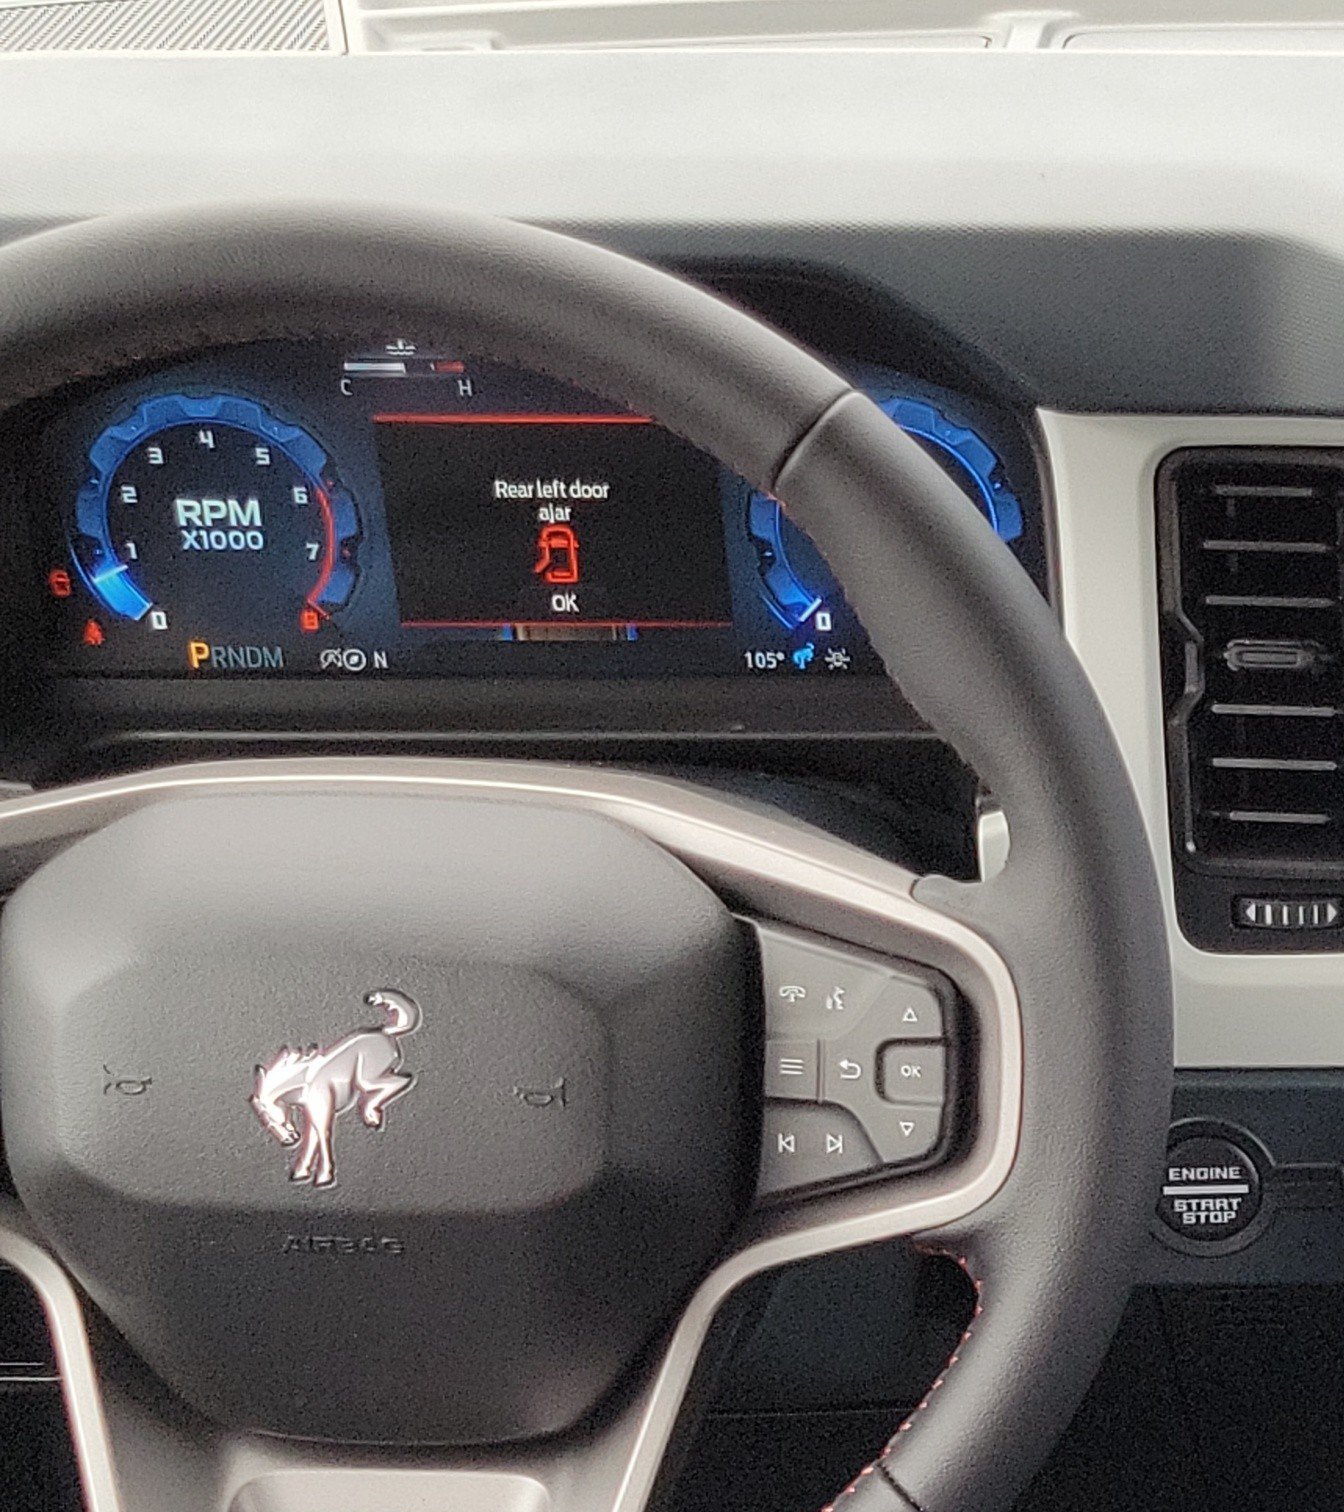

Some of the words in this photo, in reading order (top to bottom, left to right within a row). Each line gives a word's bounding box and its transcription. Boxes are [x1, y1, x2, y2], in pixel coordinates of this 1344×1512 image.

[339, 378, 353, 397] C
[457, 378, 472, 397] H
[198, 429, 216, 449] 4
[147, 446, 164, 465] 3
[255, 447, 271, 466] 5
[120, 485, 138, 504] 2
[292, 486, 309, 505] 6
[494, 479, 533, 499] Rear
[536, 478, 567, 499] left
[569, 478, 610, 499] door
[175, 498, 262, 529] RPM
[538, 503, 572, 524] ajar
[181, 529, 264, 551] X1000
[125, 541, 138, 561] 1
[304, 542, 321, 561] 7
[551, 593, 580, 613] OK
[150, 610, 168, 631] 0
[815, 611, 832, 632] 0
[373, 652, 389, 670] N
[743, 650, 785, 670] 105°
[900, 1064, 922, 1078] OK
[1168, 1166, 1242, 1181] ENGINE
[1173, 1198, 1242, 1213] START
[1182, 1210, 1238, 1225] STOP
